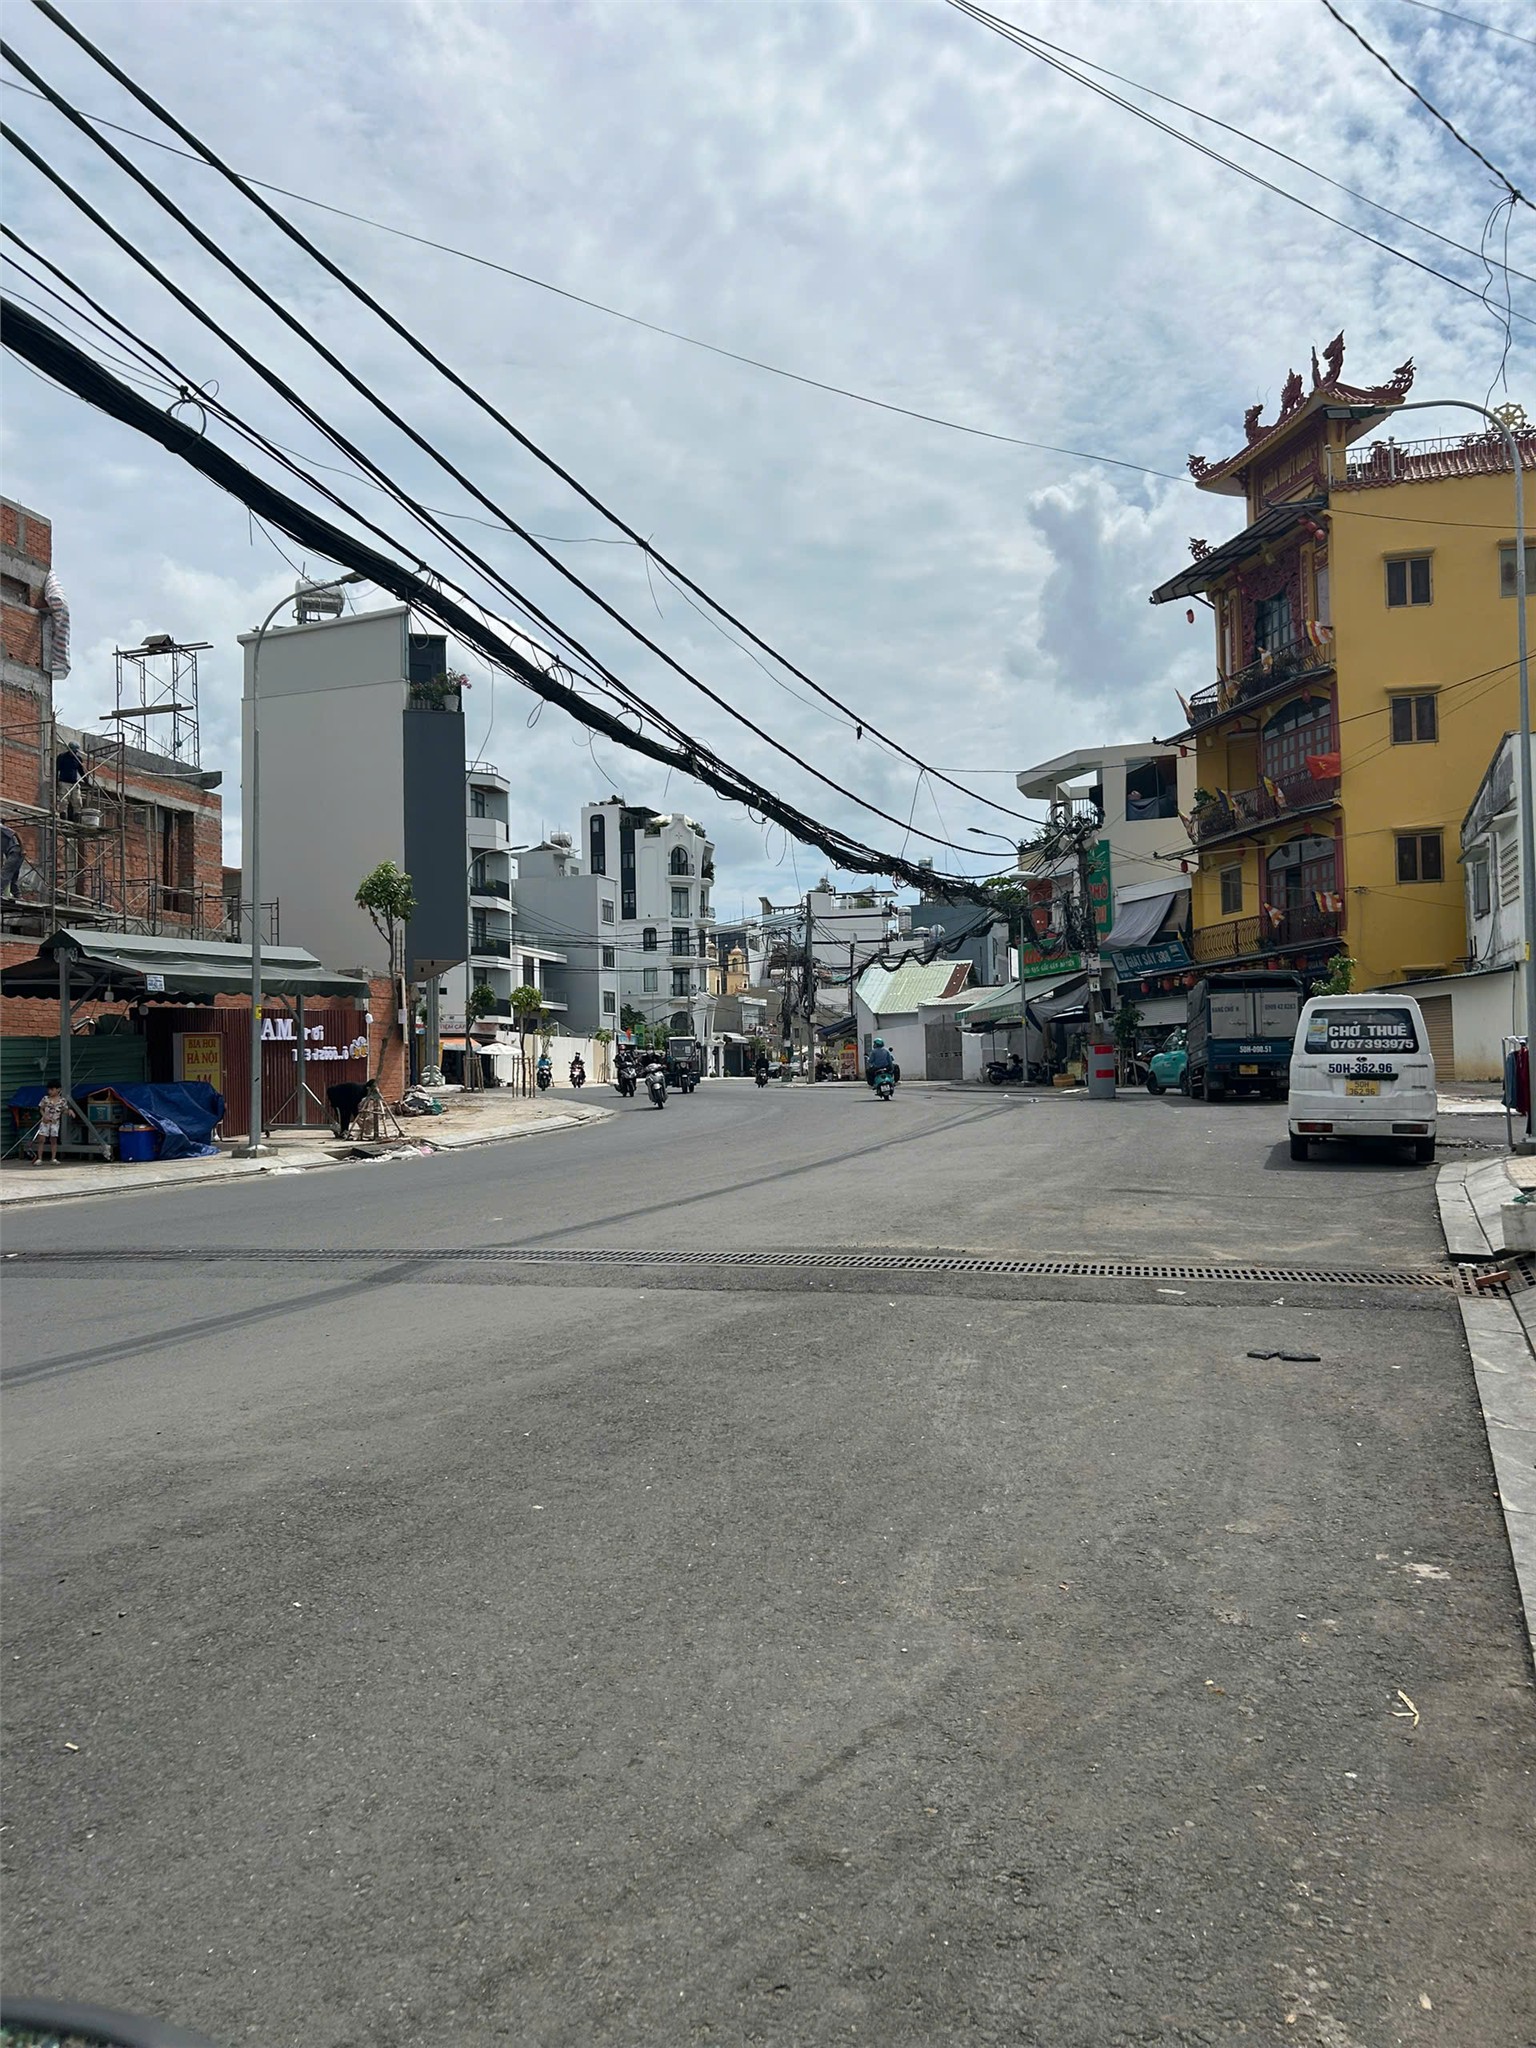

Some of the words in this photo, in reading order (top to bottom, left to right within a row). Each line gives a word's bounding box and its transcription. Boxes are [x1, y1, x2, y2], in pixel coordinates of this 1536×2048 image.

[1367, 1022, 1407, 1037] THUÊ
[188, 1039, 201, 1048] BIA
[1330, 1039, 1414, 1049] 0767393975
[187, 1050, 200, 1064] HÀ
[201, 1050, 218, 1066] NỘI
[1328, 1063, 1393, 1074] 50H-362.96
[1349, 1088, 1376, 1096] 362.96
